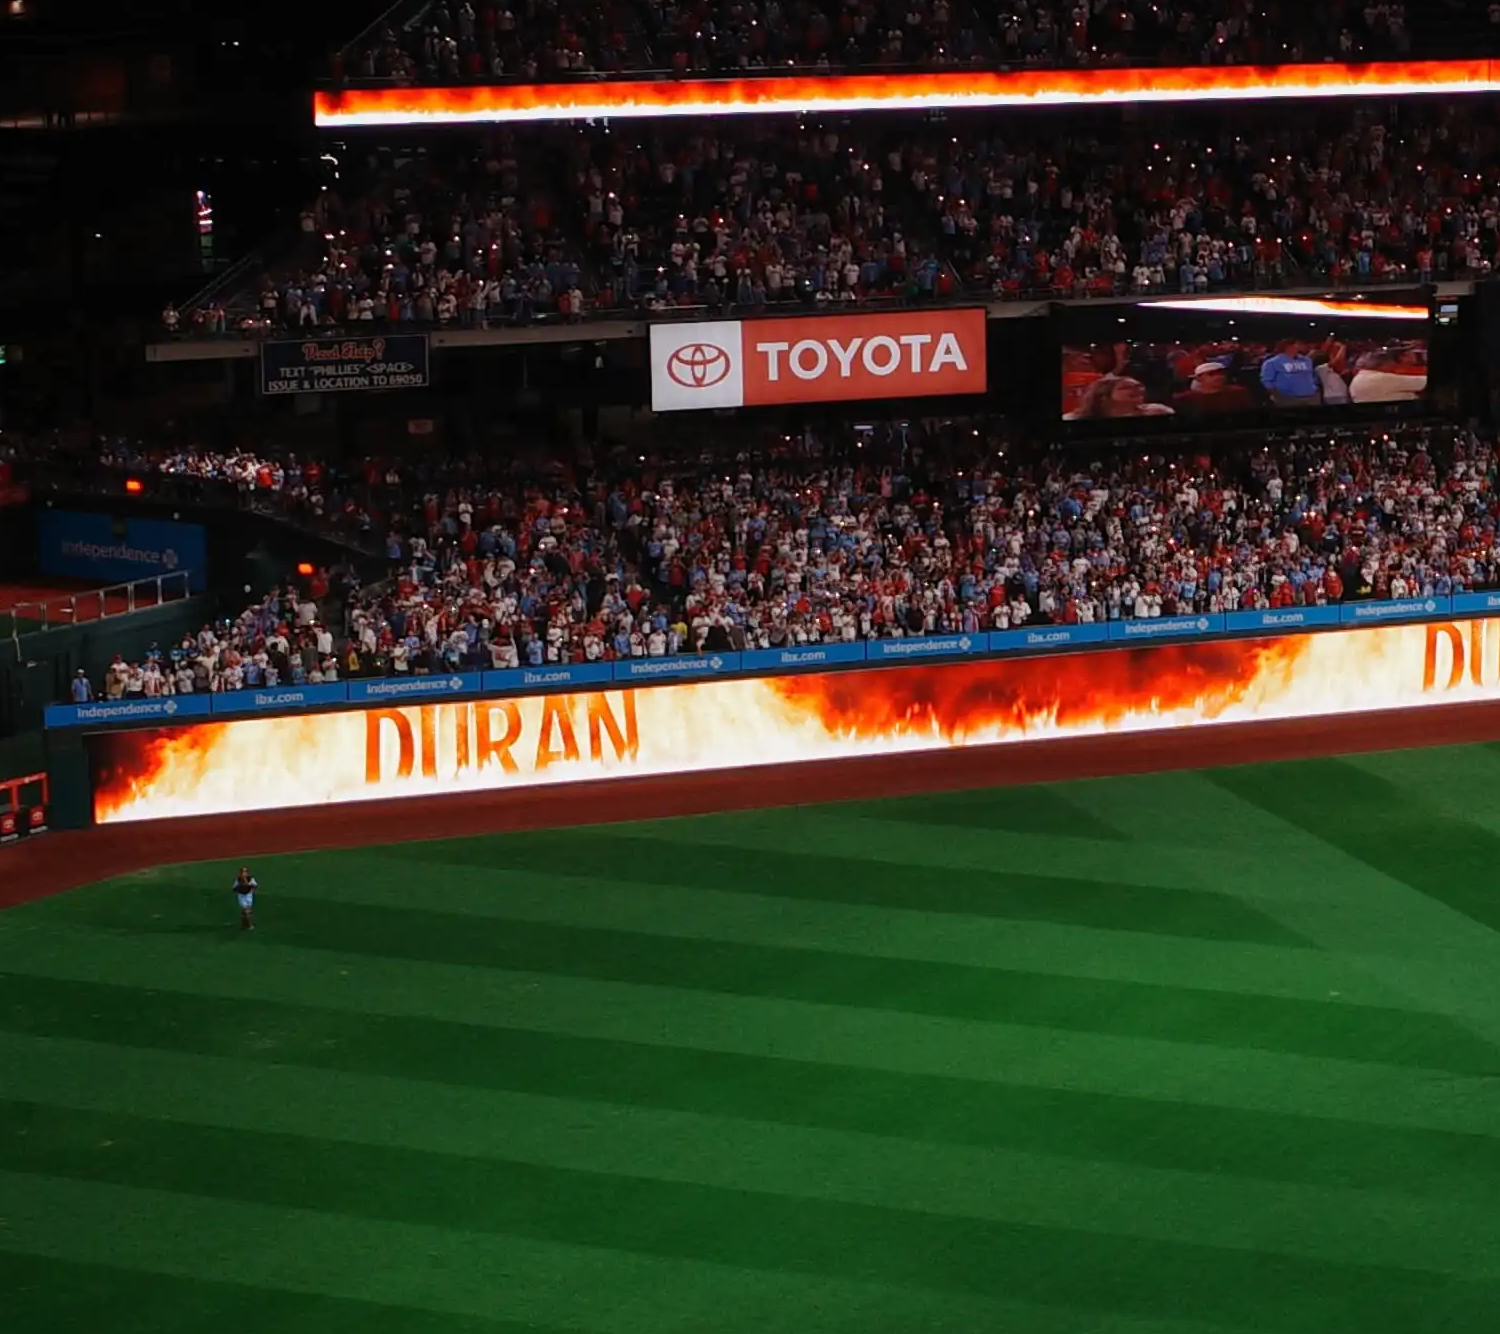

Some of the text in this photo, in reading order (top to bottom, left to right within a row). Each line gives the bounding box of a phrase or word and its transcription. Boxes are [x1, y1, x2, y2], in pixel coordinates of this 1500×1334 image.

[756, 332, 968, 381] TOYOTA
[279, 366, 306, 378] TEXT
[373, 375, 388, 386] TO
[61, 537, 161, 564] Independence
[781, 650, 826, 663] ibx.com
[631, 657, 708, 675] Independence
[524, 670, 570, 684] ibx.com
[367, 678, 447, 695] Independence
[255, 690, 304, 706] ibx.com
[77, 703, 162, 721] Independence
[365, 689, 639, 784] DURAN
